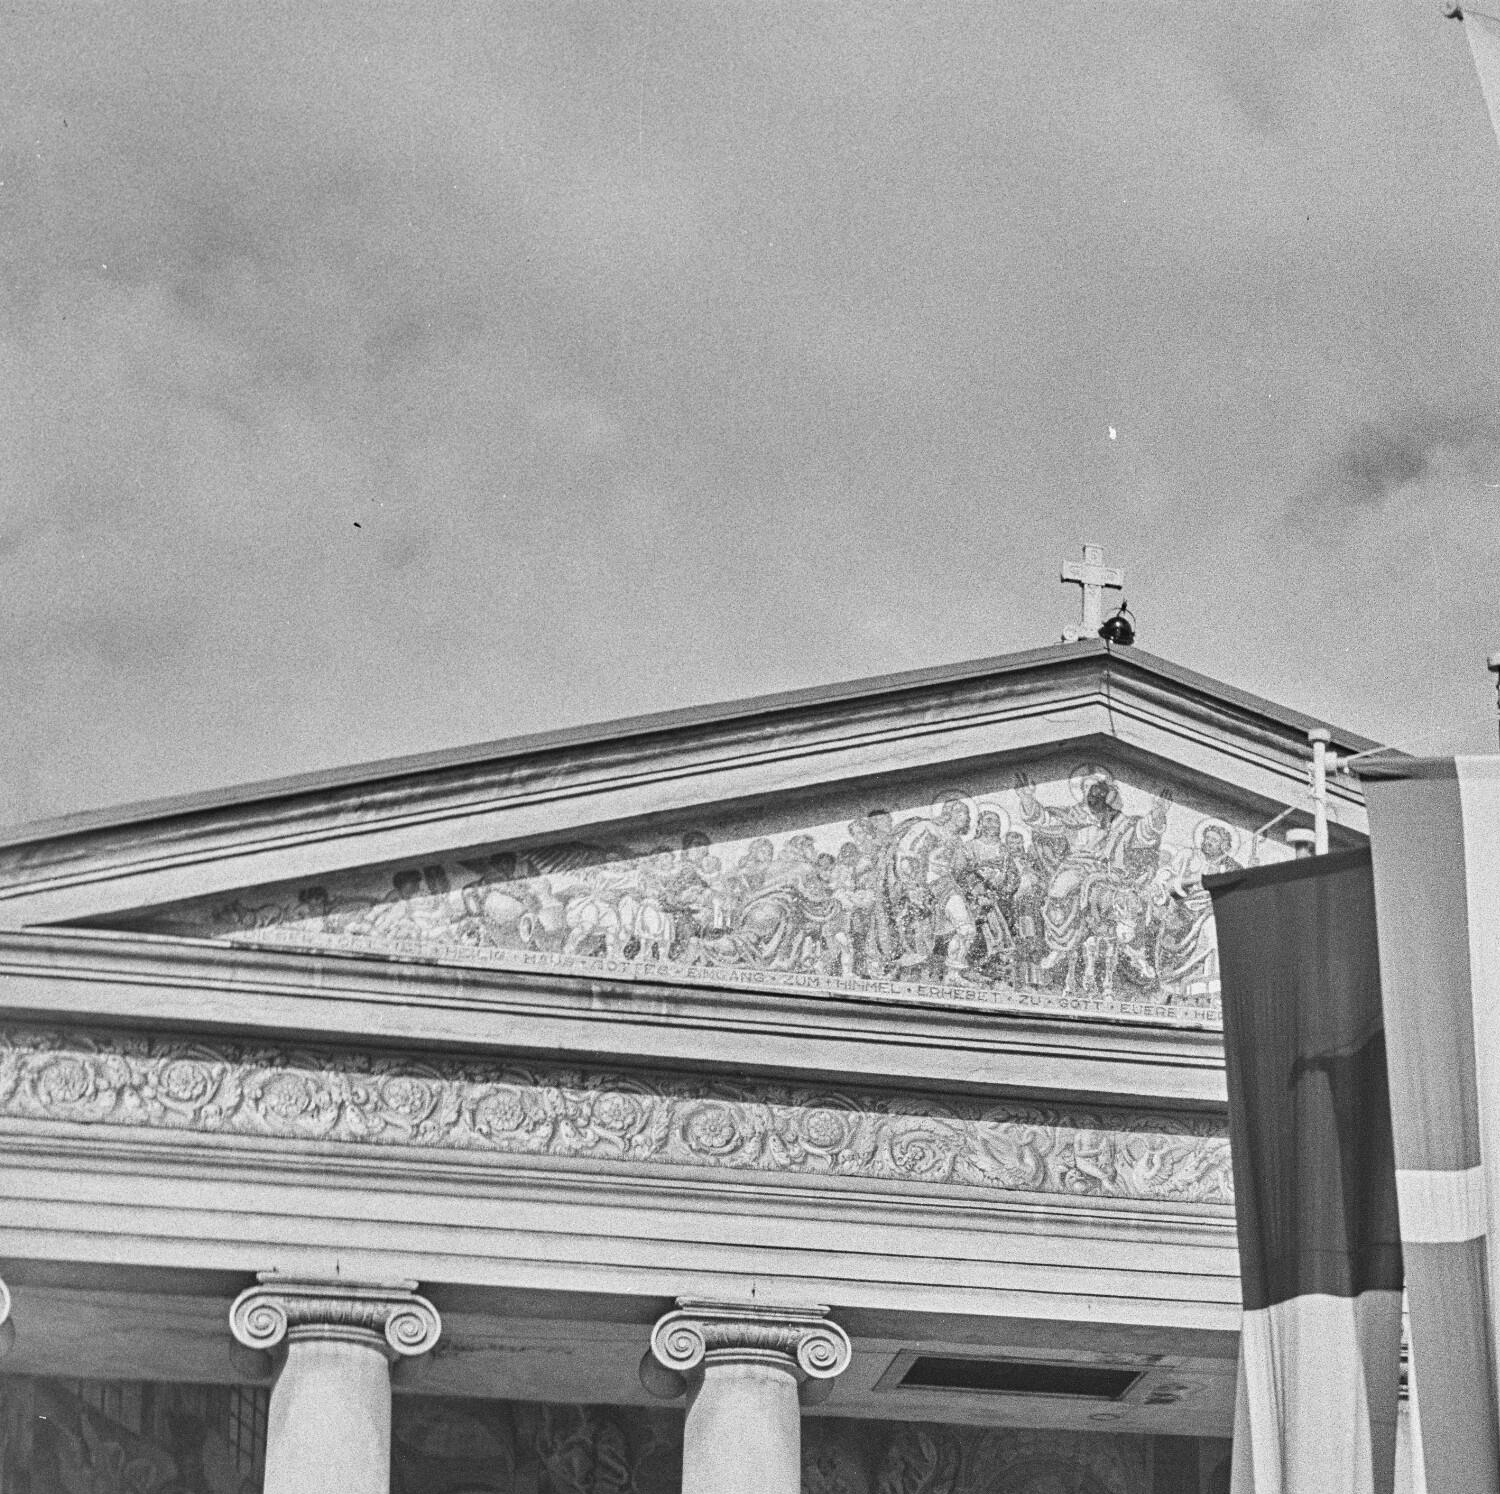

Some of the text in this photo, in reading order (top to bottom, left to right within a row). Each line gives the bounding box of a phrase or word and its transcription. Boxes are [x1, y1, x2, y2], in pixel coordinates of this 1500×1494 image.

[592, 959, 668, 976] GOTTES
[687, 967, 764, 983] EINGANG
[783, 975, 820, 988] ZUM
[835, 978, 899, 994] HIMMEL
[917, 985, 1000, 1003] ERHEBET
[1019, 994, 1042, 1006] ZU
[1060, 1000, 1102, 1011] GOTT
[1120, 1003, 1176, 1018] EUERE
